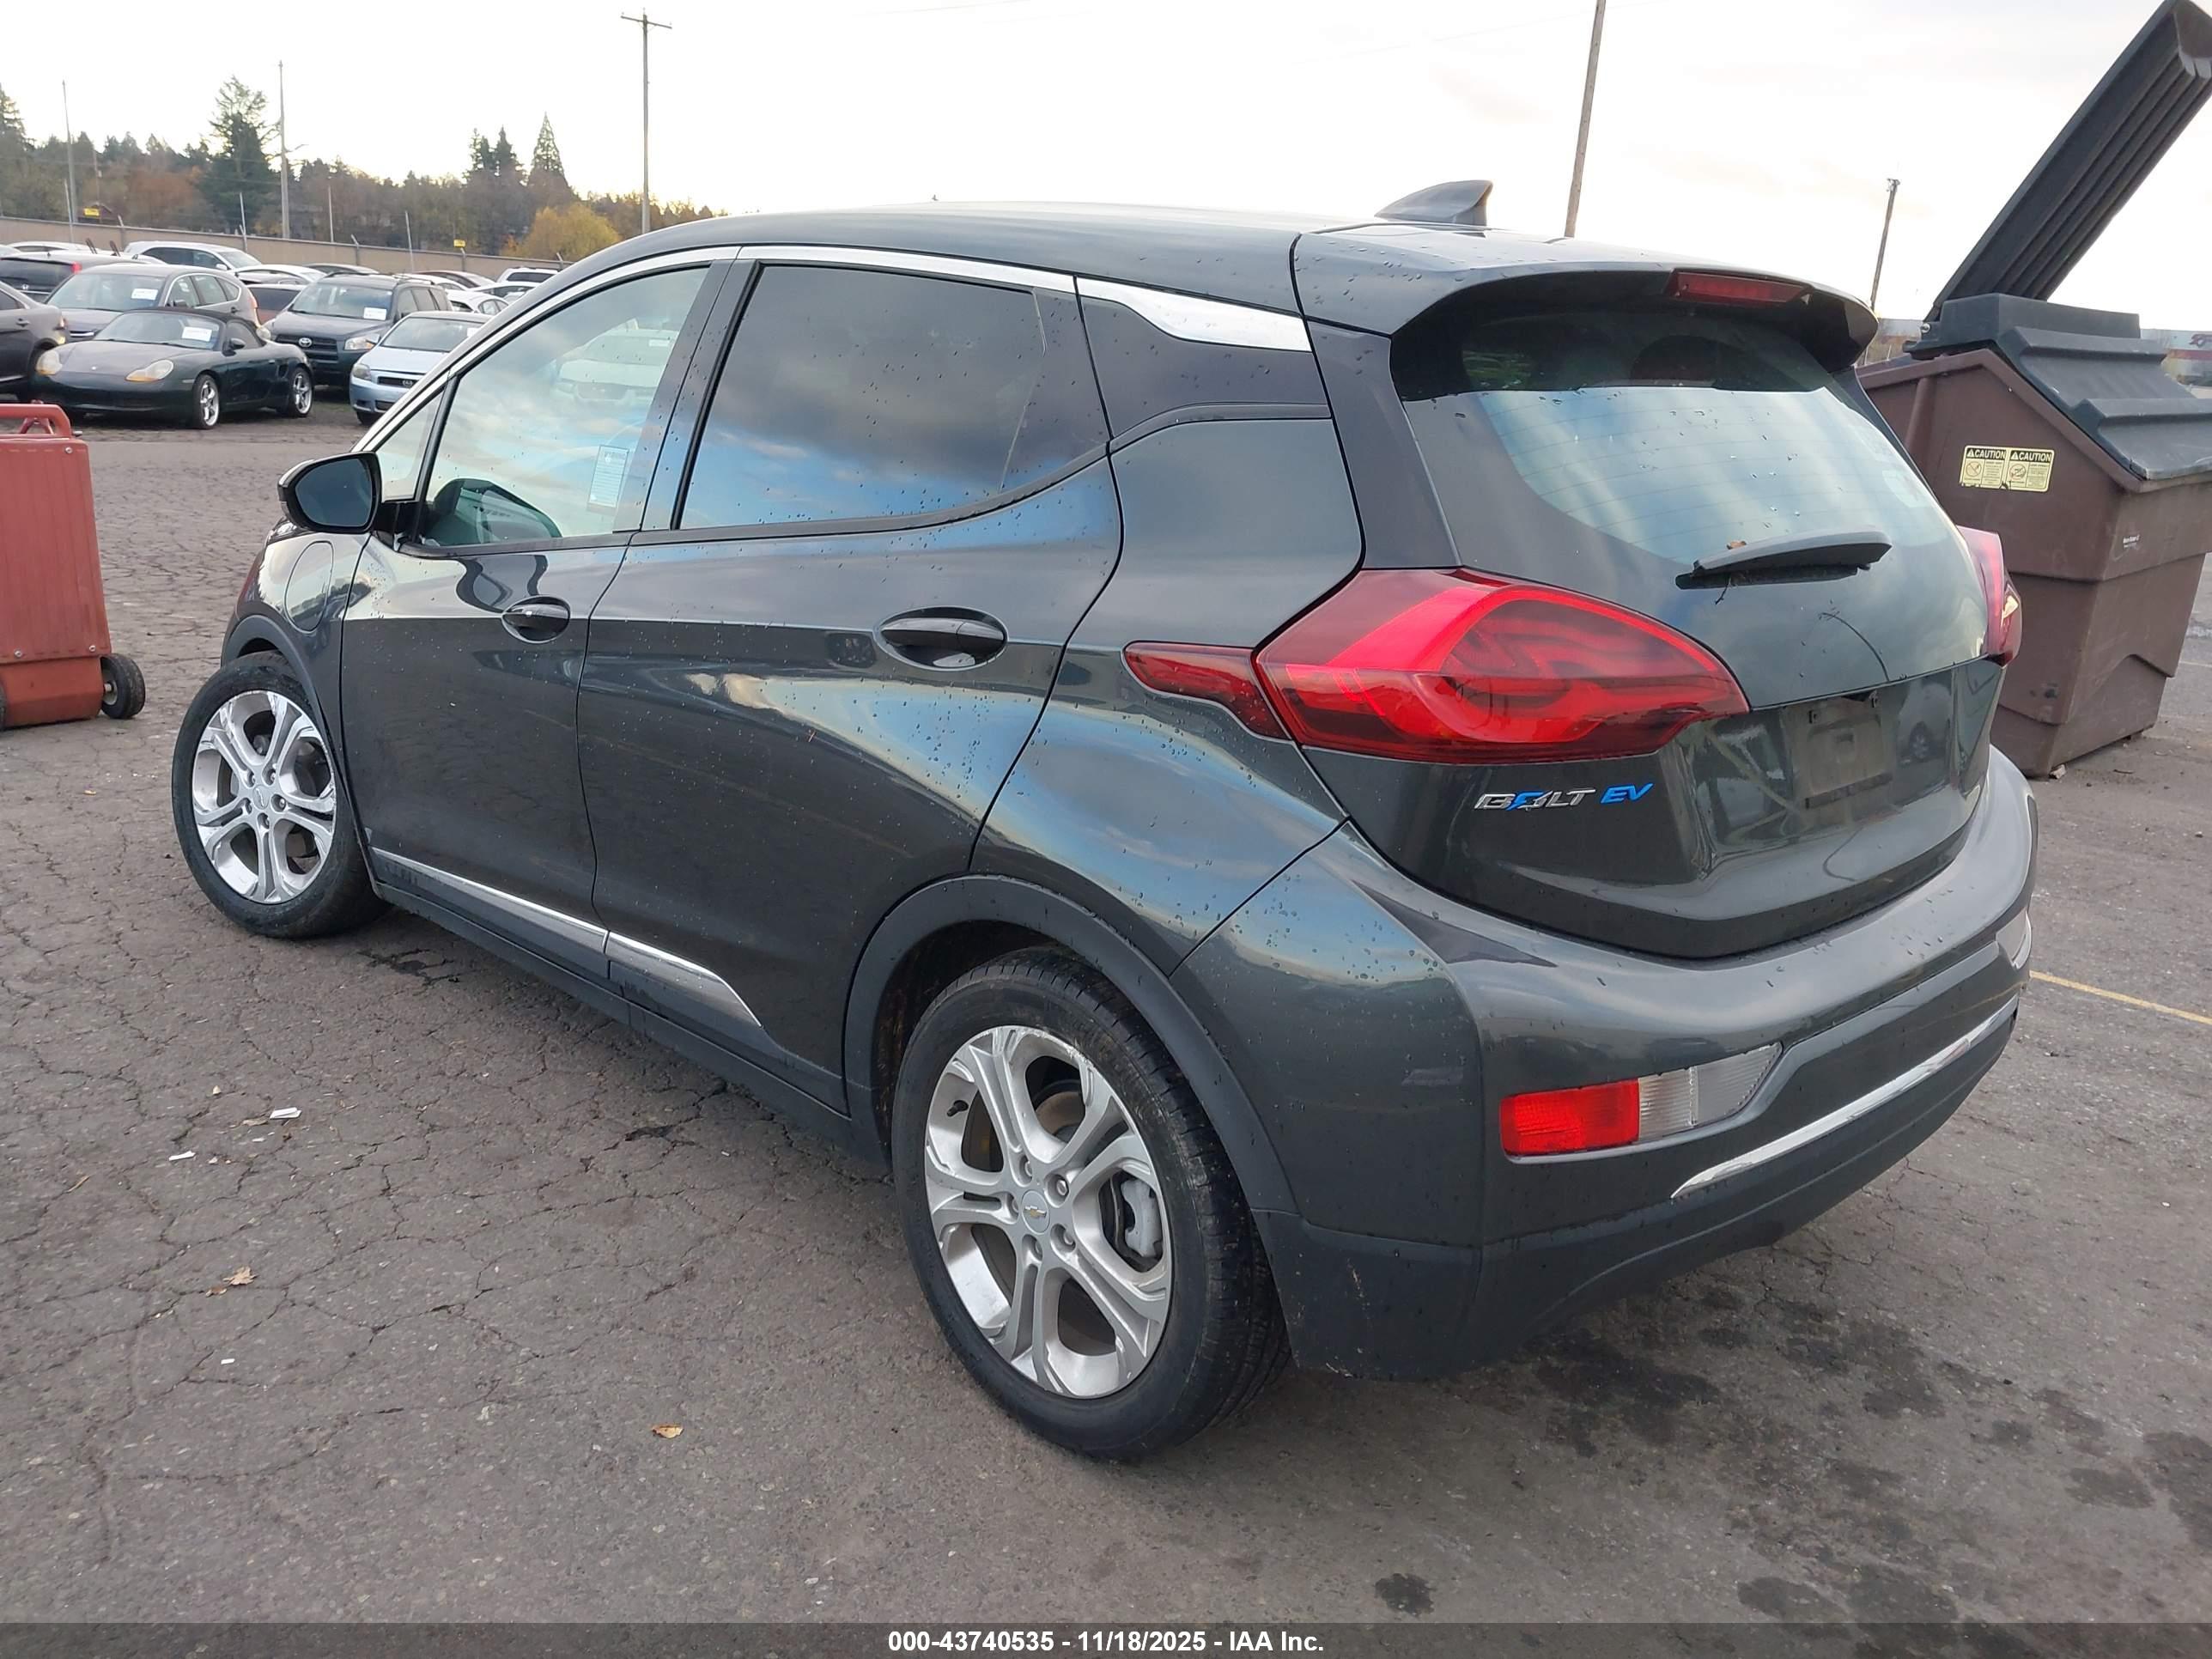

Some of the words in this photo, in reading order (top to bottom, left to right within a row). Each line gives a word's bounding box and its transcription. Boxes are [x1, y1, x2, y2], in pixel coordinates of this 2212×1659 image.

[1975, 449, 2007, 459] CAUTION
[2019, 452, 2052, 462] CAUTION
[1474, 787, 1596, 811] BOLT
[1600, 782, 1654, 805] EV
